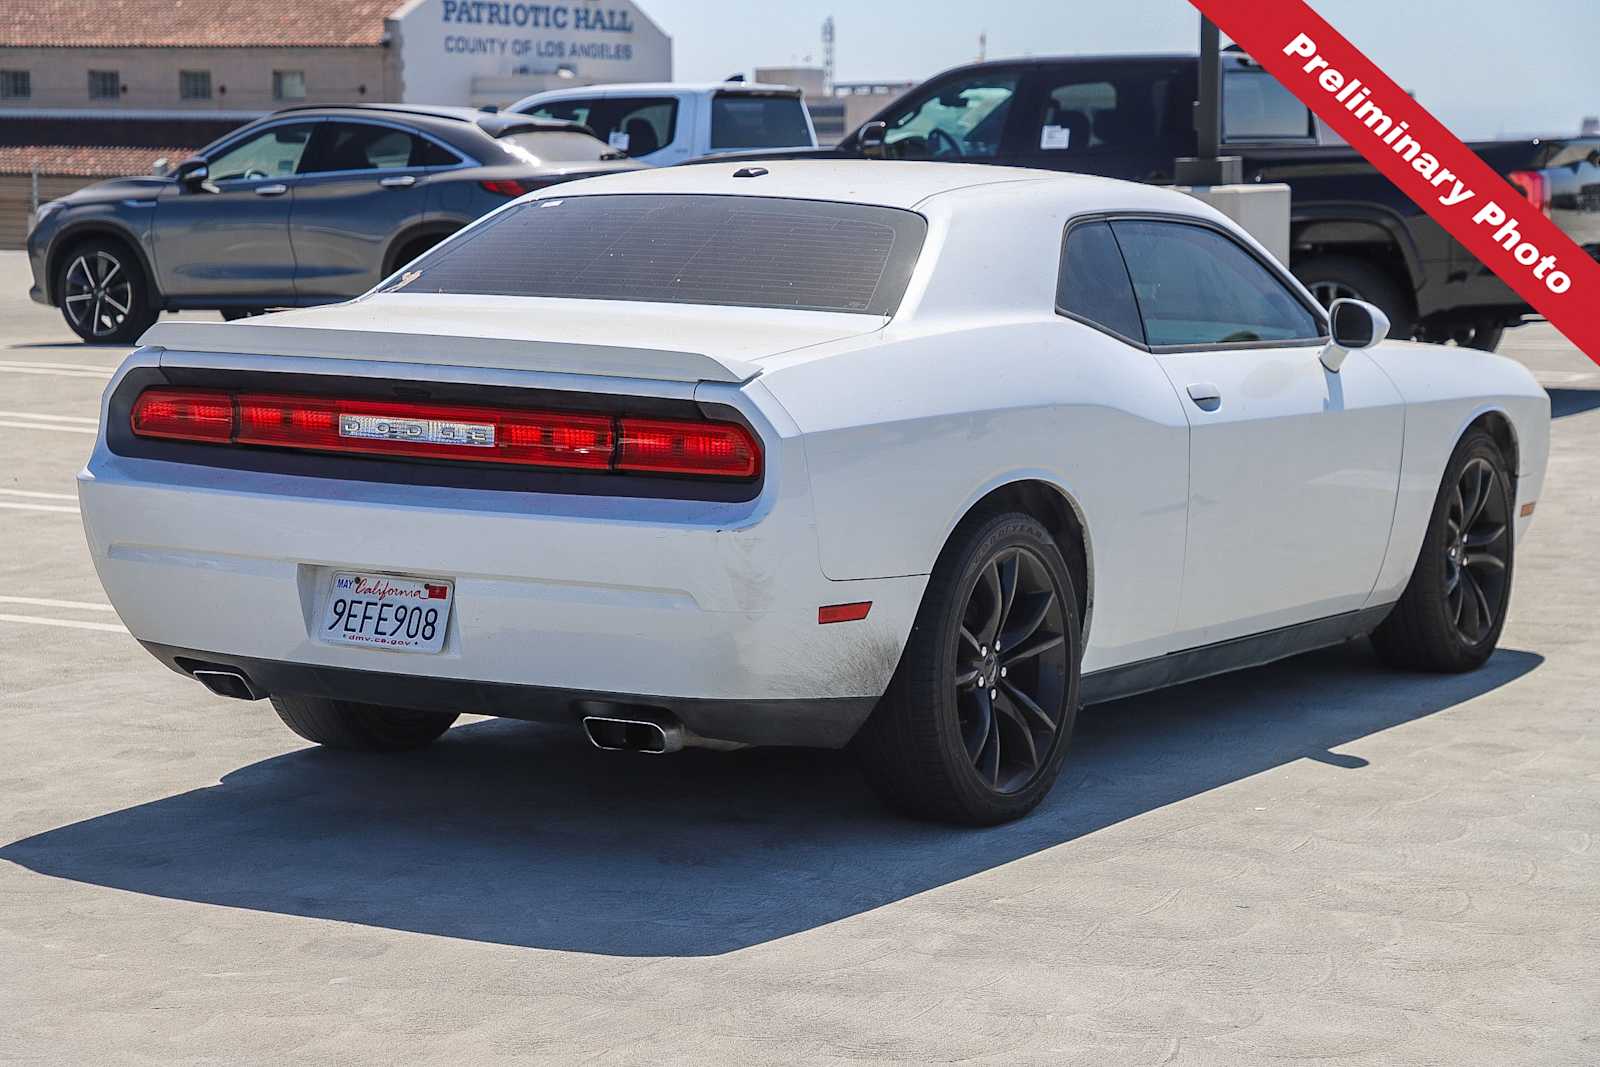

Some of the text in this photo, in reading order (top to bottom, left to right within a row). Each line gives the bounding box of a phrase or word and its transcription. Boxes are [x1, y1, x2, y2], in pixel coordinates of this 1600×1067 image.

[442, 1, 633, 32] PATRIOTIC HALL
[444, 36, 633, 61] COUNTY OF LOS ANGELES
[345, 420, 487, 440] DODGE
[336, 578, 354, 589] MAY
[353, 577, 430, 601] California
[328, 598, 438, 641] 9EFE908
[348, 634, 411, 647] dmv.ca.gov
